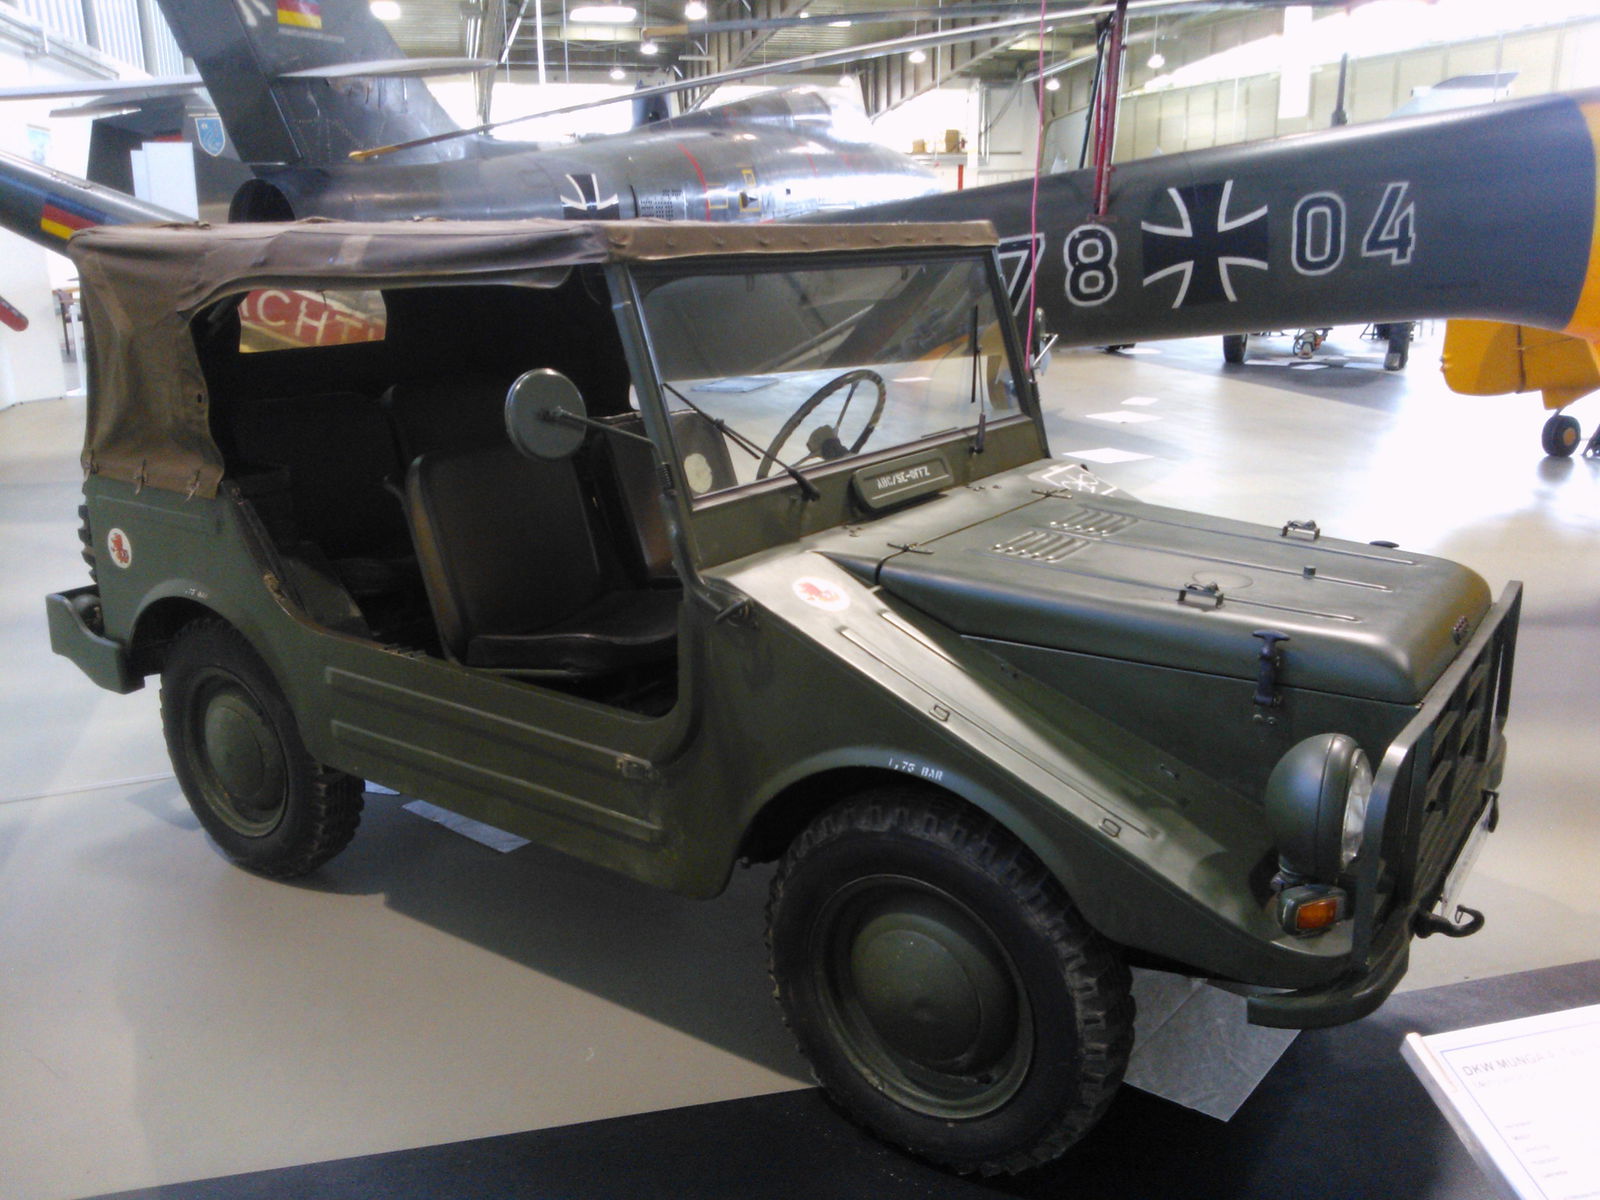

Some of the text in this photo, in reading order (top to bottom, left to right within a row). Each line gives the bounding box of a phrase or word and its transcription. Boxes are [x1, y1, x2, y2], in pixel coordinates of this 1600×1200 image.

[999, 181, 1416, 316] 78 04
[240, 289, 376, 345] CHT
[921, 766, 943, 781] BAR
[1462, 1052, 1545, 1076] DKW MUNGA
